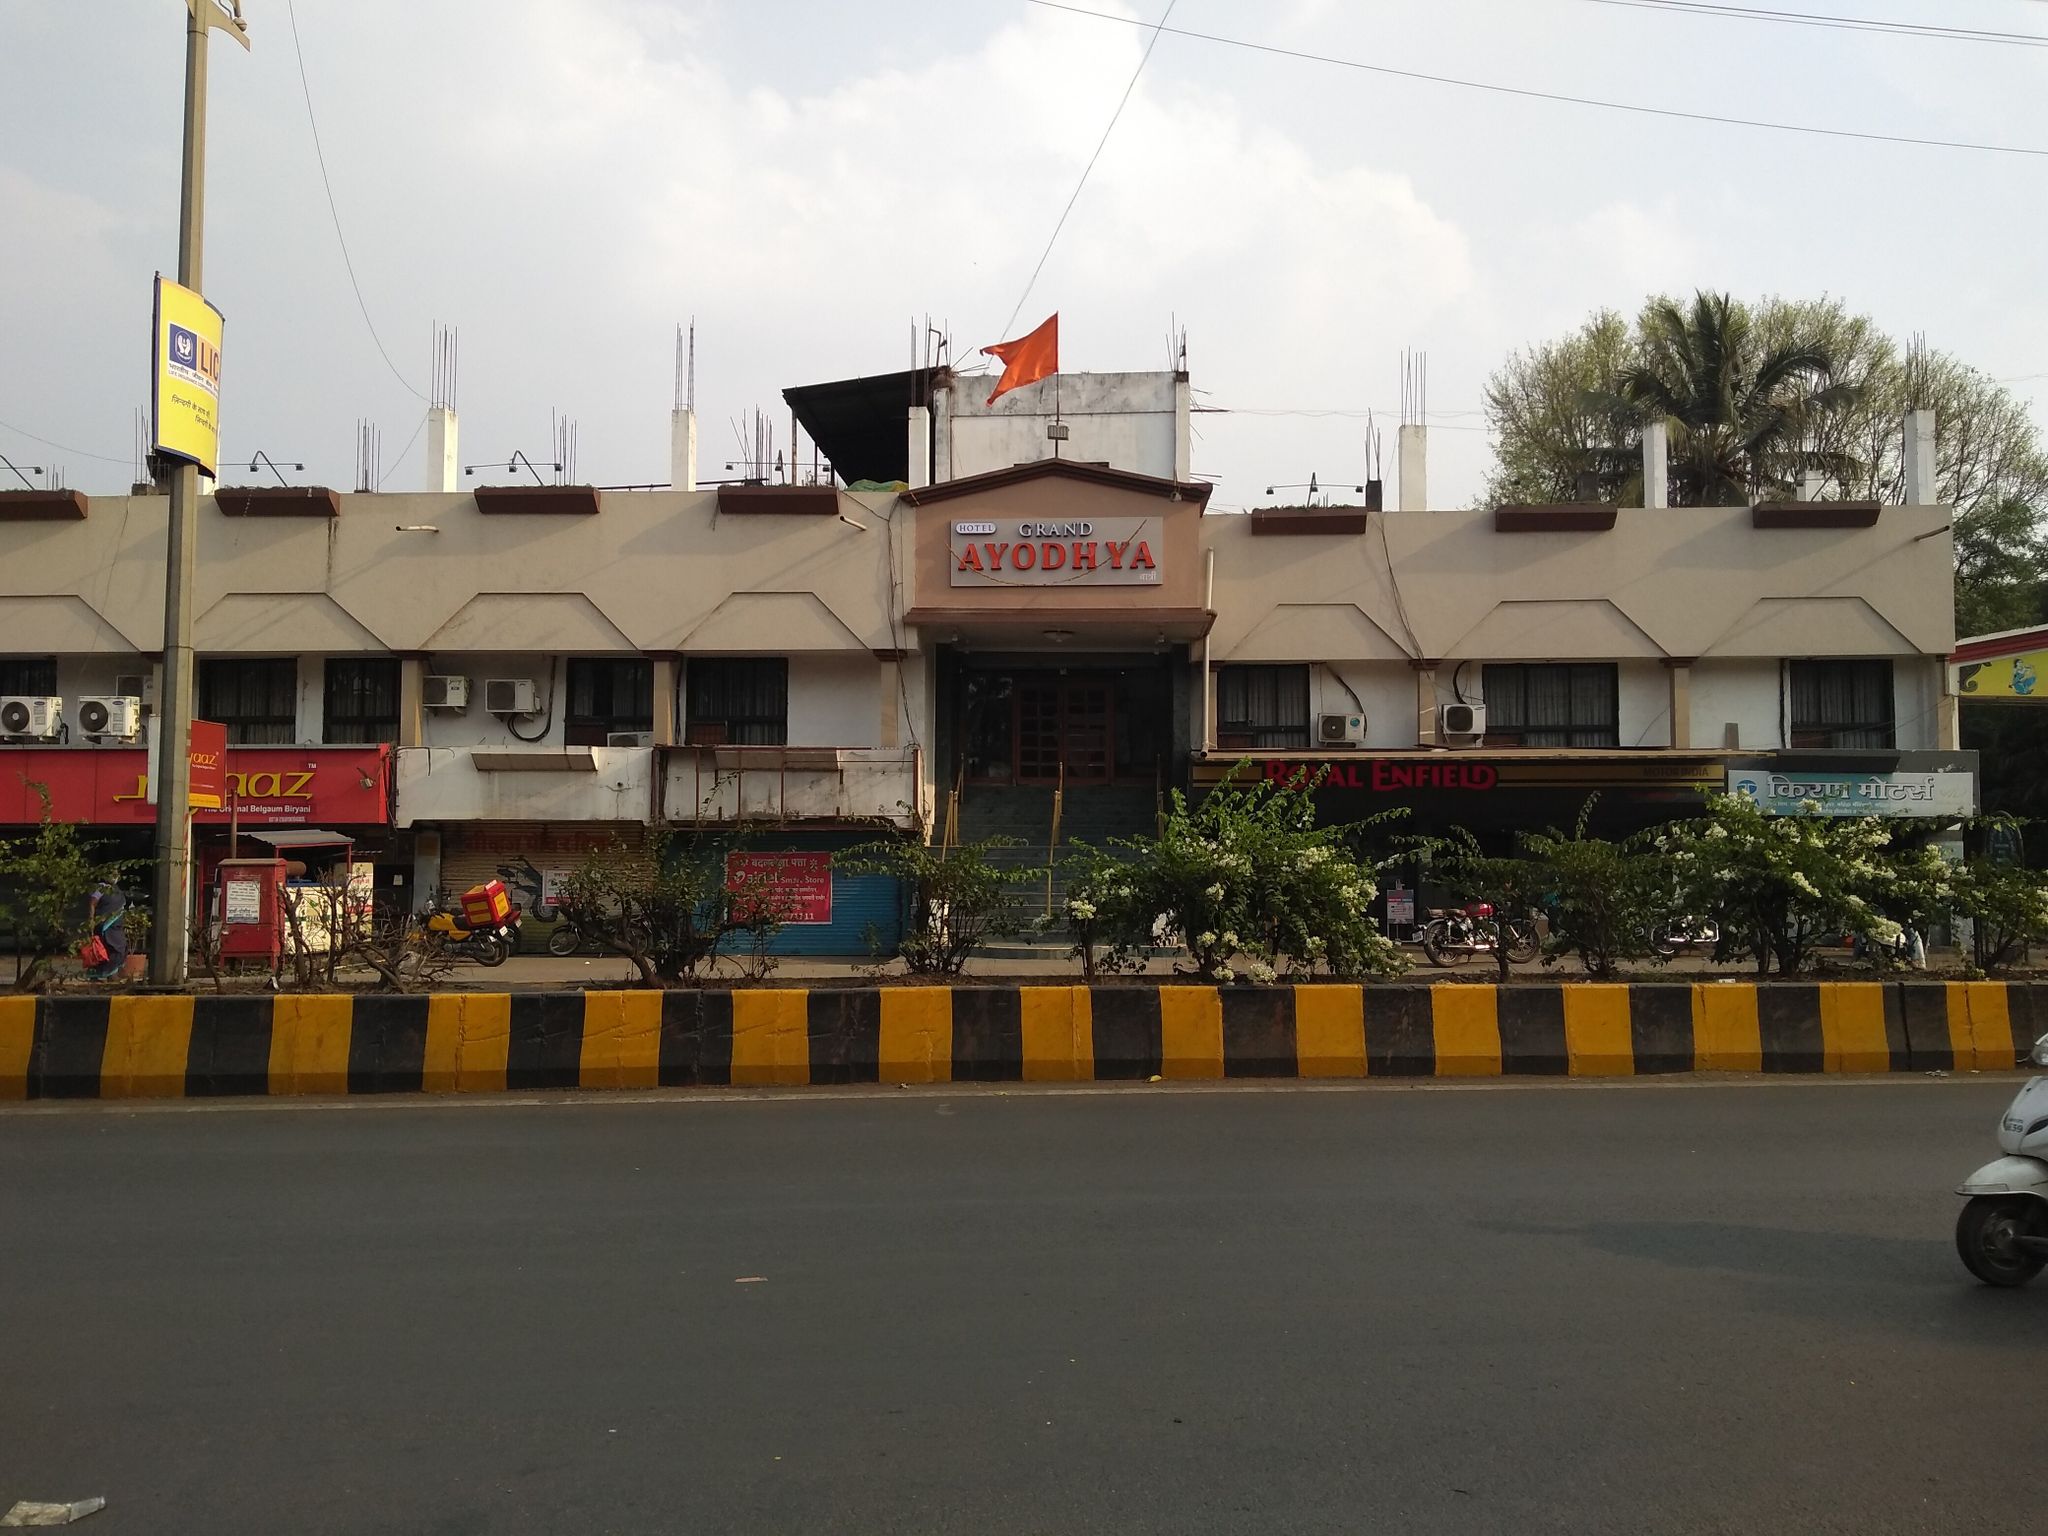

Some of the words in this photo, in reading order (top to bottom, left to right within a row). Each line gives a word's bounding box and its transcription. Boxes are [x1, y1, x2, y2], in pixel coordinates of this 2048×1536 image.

[201, 342, 219, 382] LIC
[959, 524, 994, 532] HOTEL
[1019, 522, 1094, 537] GRAND
[957, 541, 1157, 571] AYODHYA
[1371, 759, 1498, 791] ENFIELD
[1767, 774, 1851, 799] किरण
[1857, 776, 1935, 800] मोटर्स
[219, 805, 249, 813] Orinal
[250, 805, 283, 814] Belgaum
[285, 805, 311, 814] Biryani
[805, 875, 825, 884] Store
